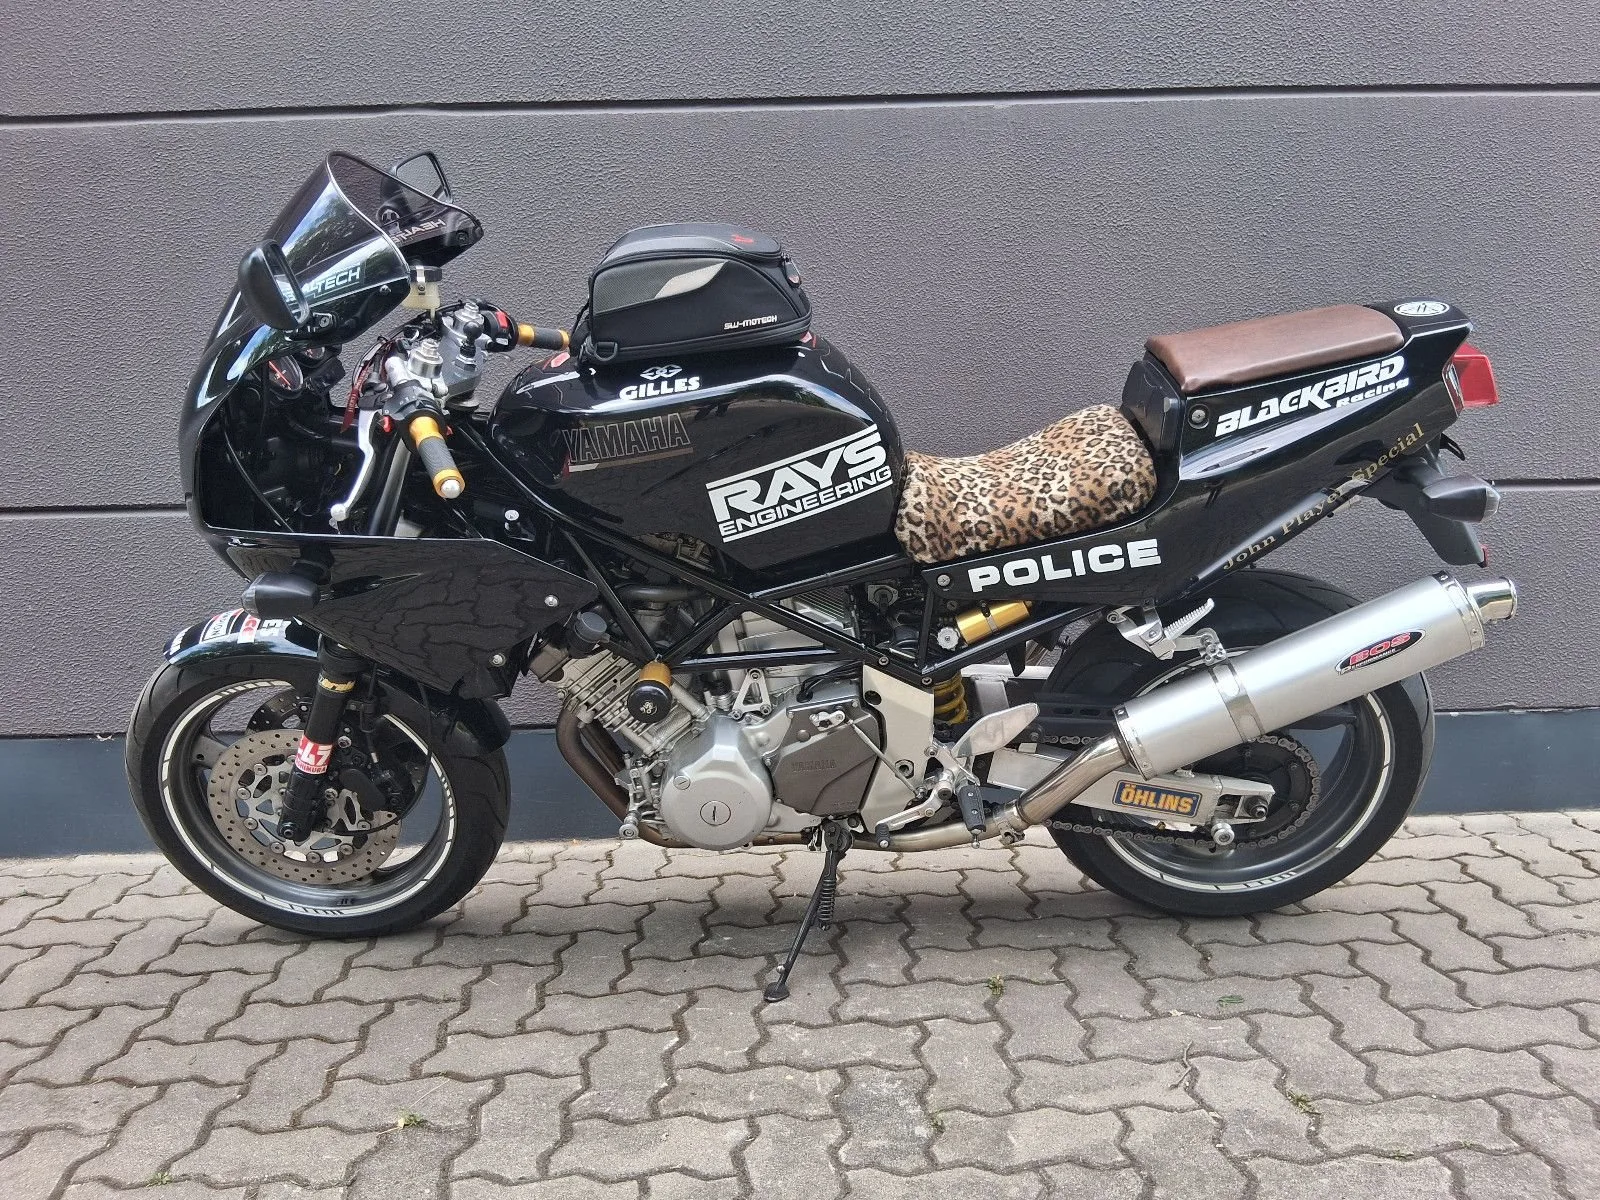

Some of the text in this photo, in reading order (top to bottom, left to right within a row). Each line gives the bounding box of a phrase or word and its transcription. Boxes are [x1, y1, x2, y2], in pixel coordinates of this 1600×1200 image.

[724, 315, 777, 330] SW-MOTECH
[619, 376, 700, 400] GILLES
[1215, 356, 1404, 437] BLACKBIRD
[562, 412, 691, 463] YAMAHA
[707, 432, 887, 522] RAYS
[719, 465, 893, 537] ENGINEERING
[1224, 535, 1276, 570] John
[1351, 422, 1425, 481] Special
[968, 539, 1161, 593] POLICE
[1350, 632, 1410, 665] BOS
[1120, 784, 1194, 813] ÖHLINS
